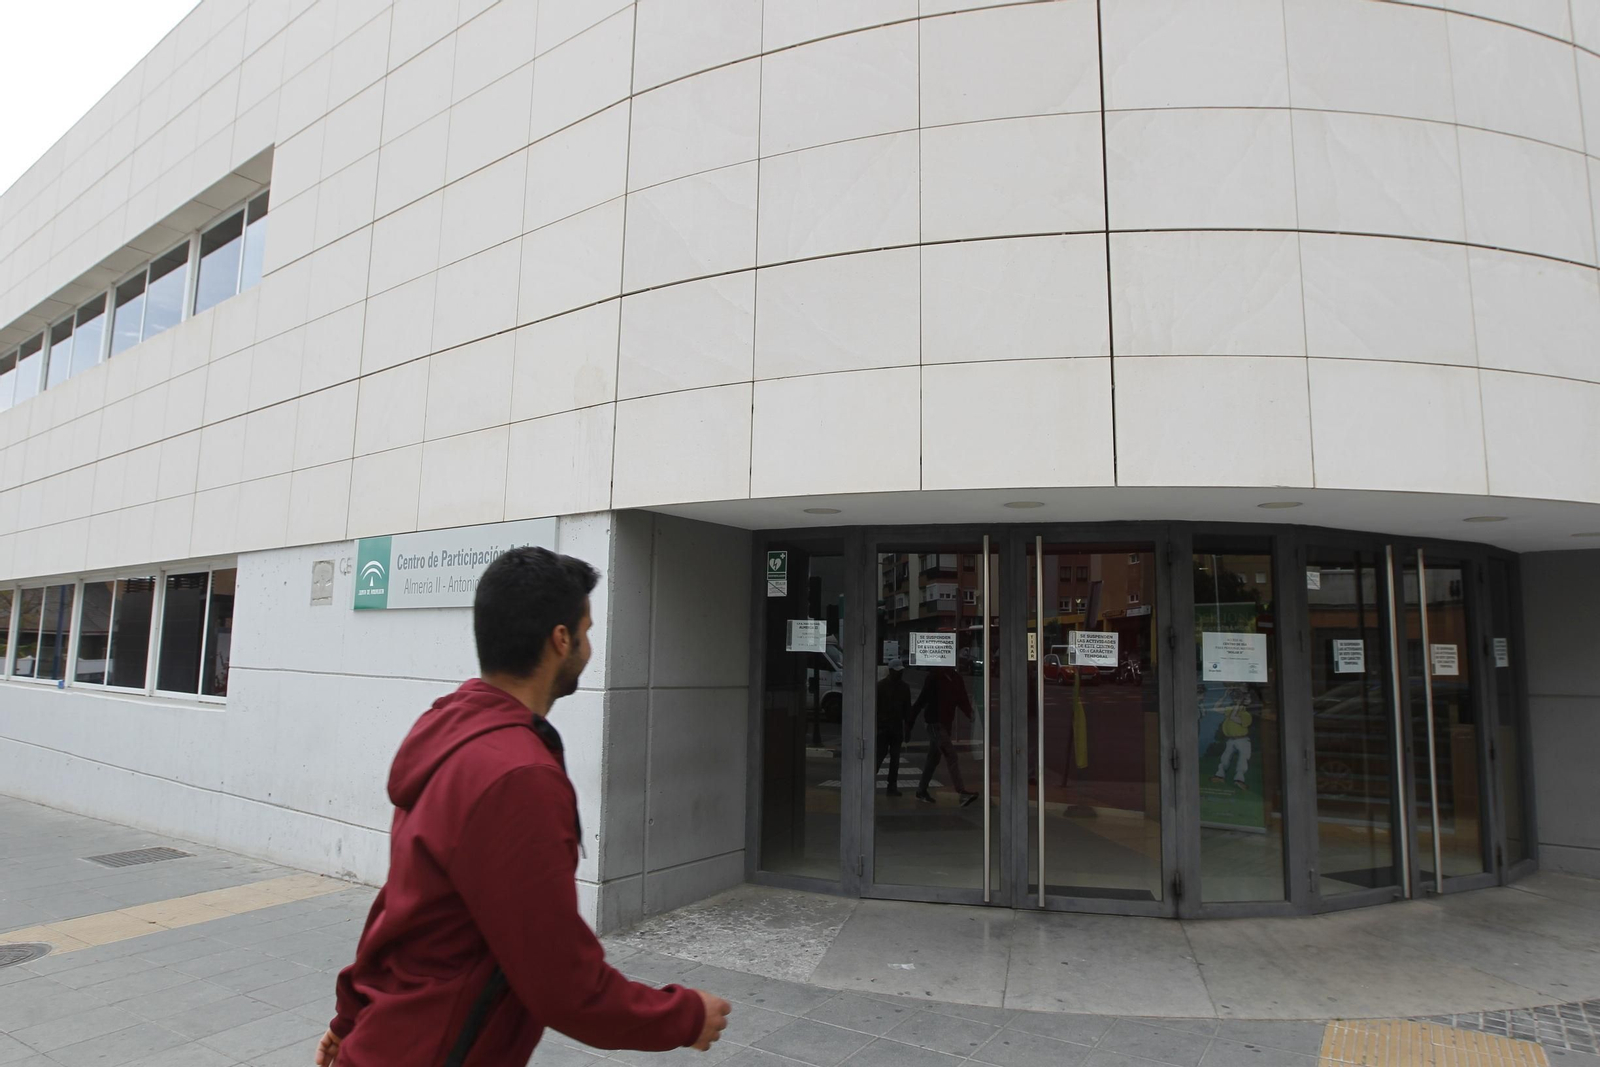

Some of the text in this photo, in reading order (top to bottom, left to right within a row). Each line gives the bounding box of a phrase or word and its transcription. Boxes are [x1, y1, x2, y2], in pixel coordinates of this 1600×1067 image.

[397, 553, 426, 571] Centro
[427, 551, 439, 568] de
[404, 578, 433, 595] Almería
